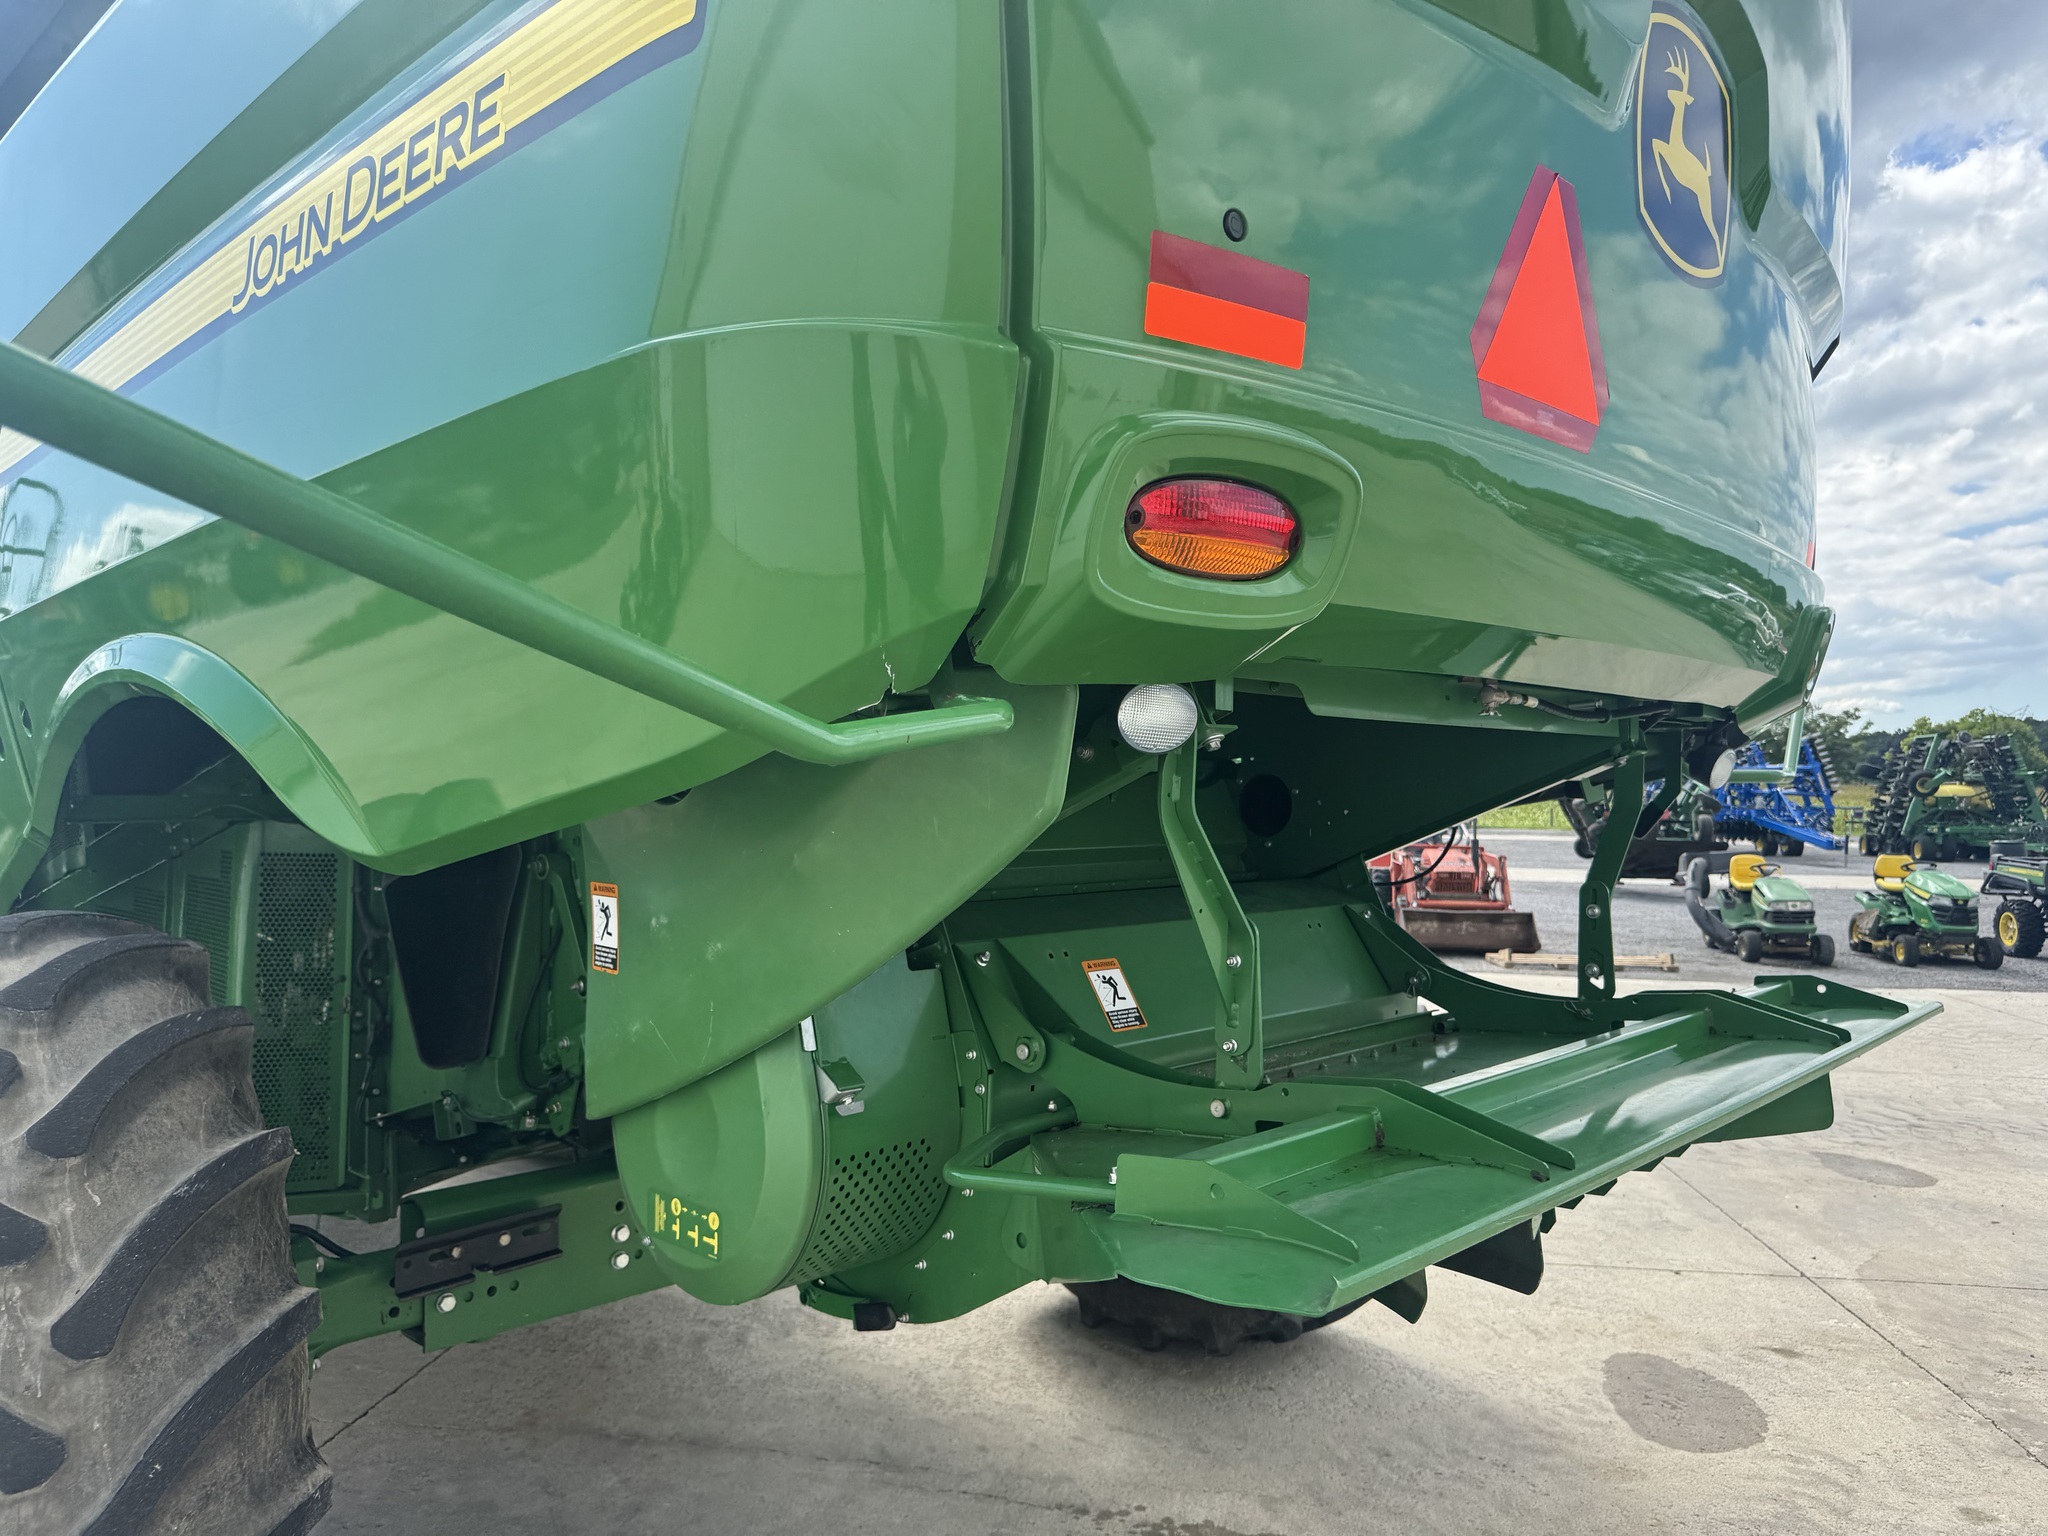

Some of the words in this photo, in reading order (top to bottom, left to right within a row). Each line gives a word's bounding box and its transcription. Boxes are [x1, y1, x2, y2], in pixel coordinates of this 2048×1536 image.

[232, 190, 335, 310] JOHN
[340, 71, 507, 239] DEERE
[1092, 960, 1116, 968] WARNING
